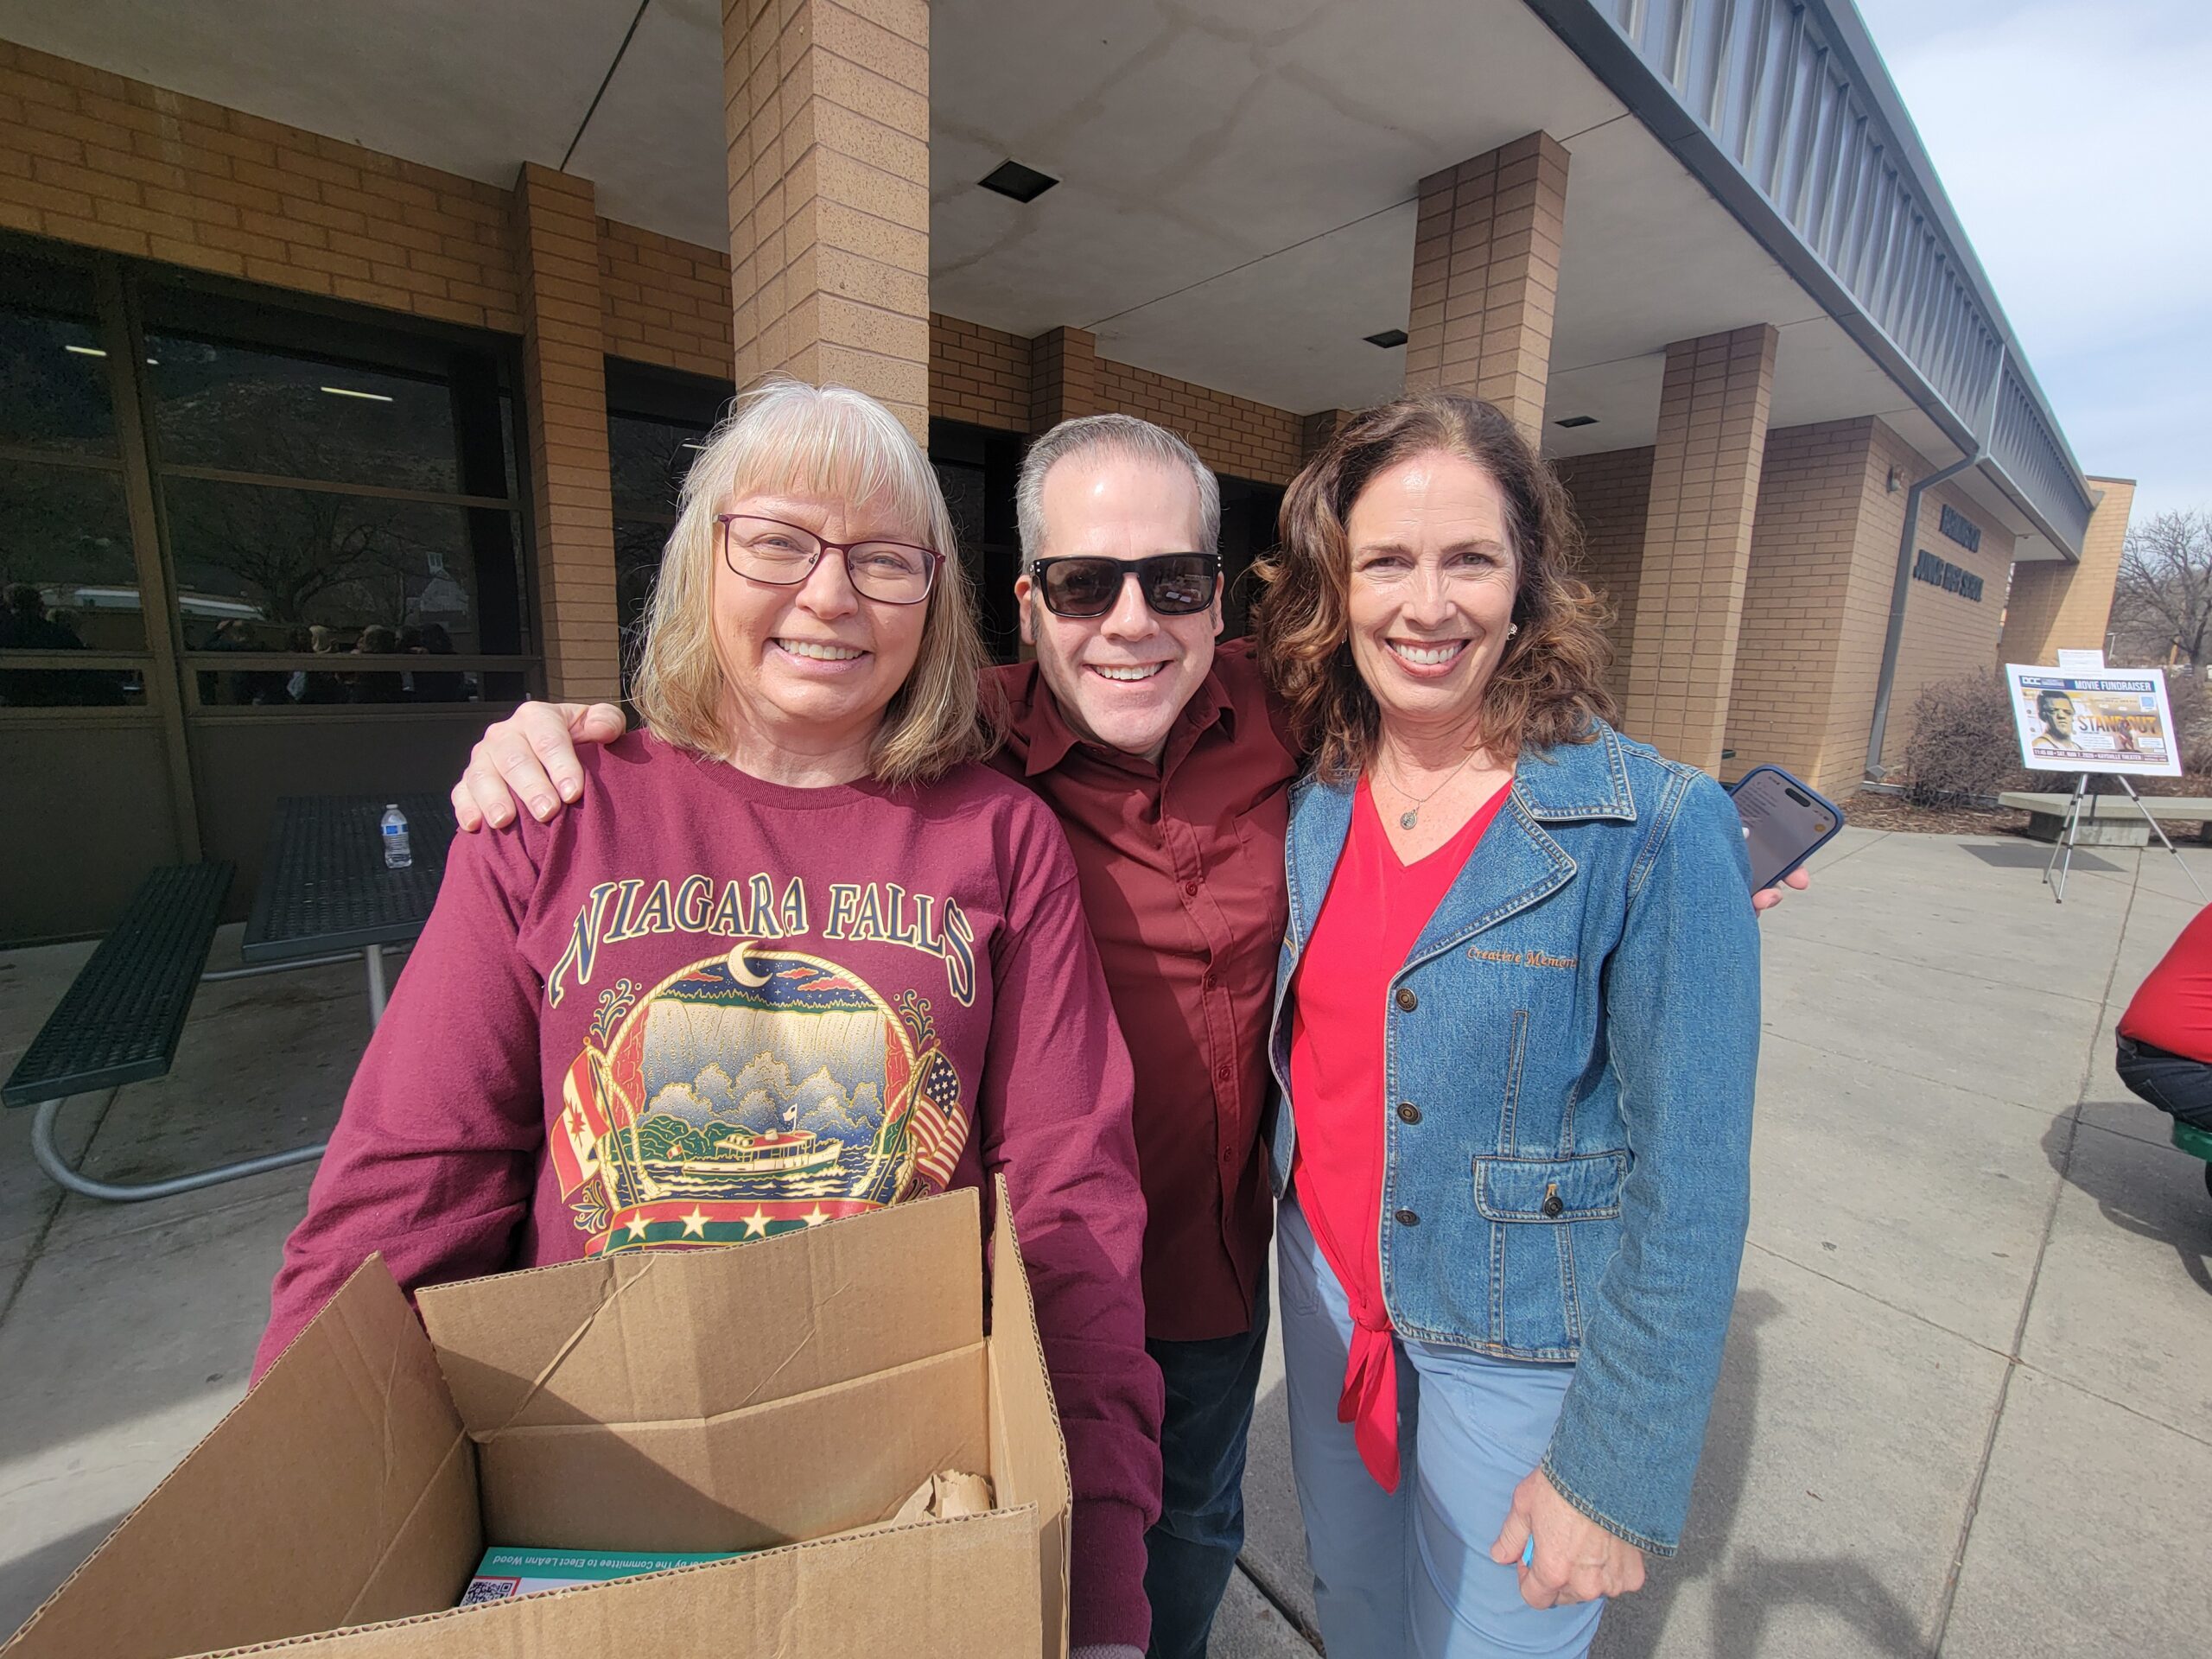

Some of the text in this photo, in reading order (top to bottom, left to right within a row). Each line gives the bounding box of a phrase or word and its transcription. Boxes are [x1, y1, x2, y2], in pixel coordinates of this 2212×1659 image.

[2075, 680, 2100, 690] MOVIE
[2101, 681, 2152, 691] FUNDRAISER
[549, 872, 976, 1008] NIAGARA FALLS
[1467, 946, 1521, 963] Creative
[493, 1555, 523, 1566] Wood
[524, 1556, 558, 1567] LeAnn
[559, 1558, 585, 1567] Elect
[588, 1559, 598, 1568] to
[600, 1560, 653, 1570] Committee
